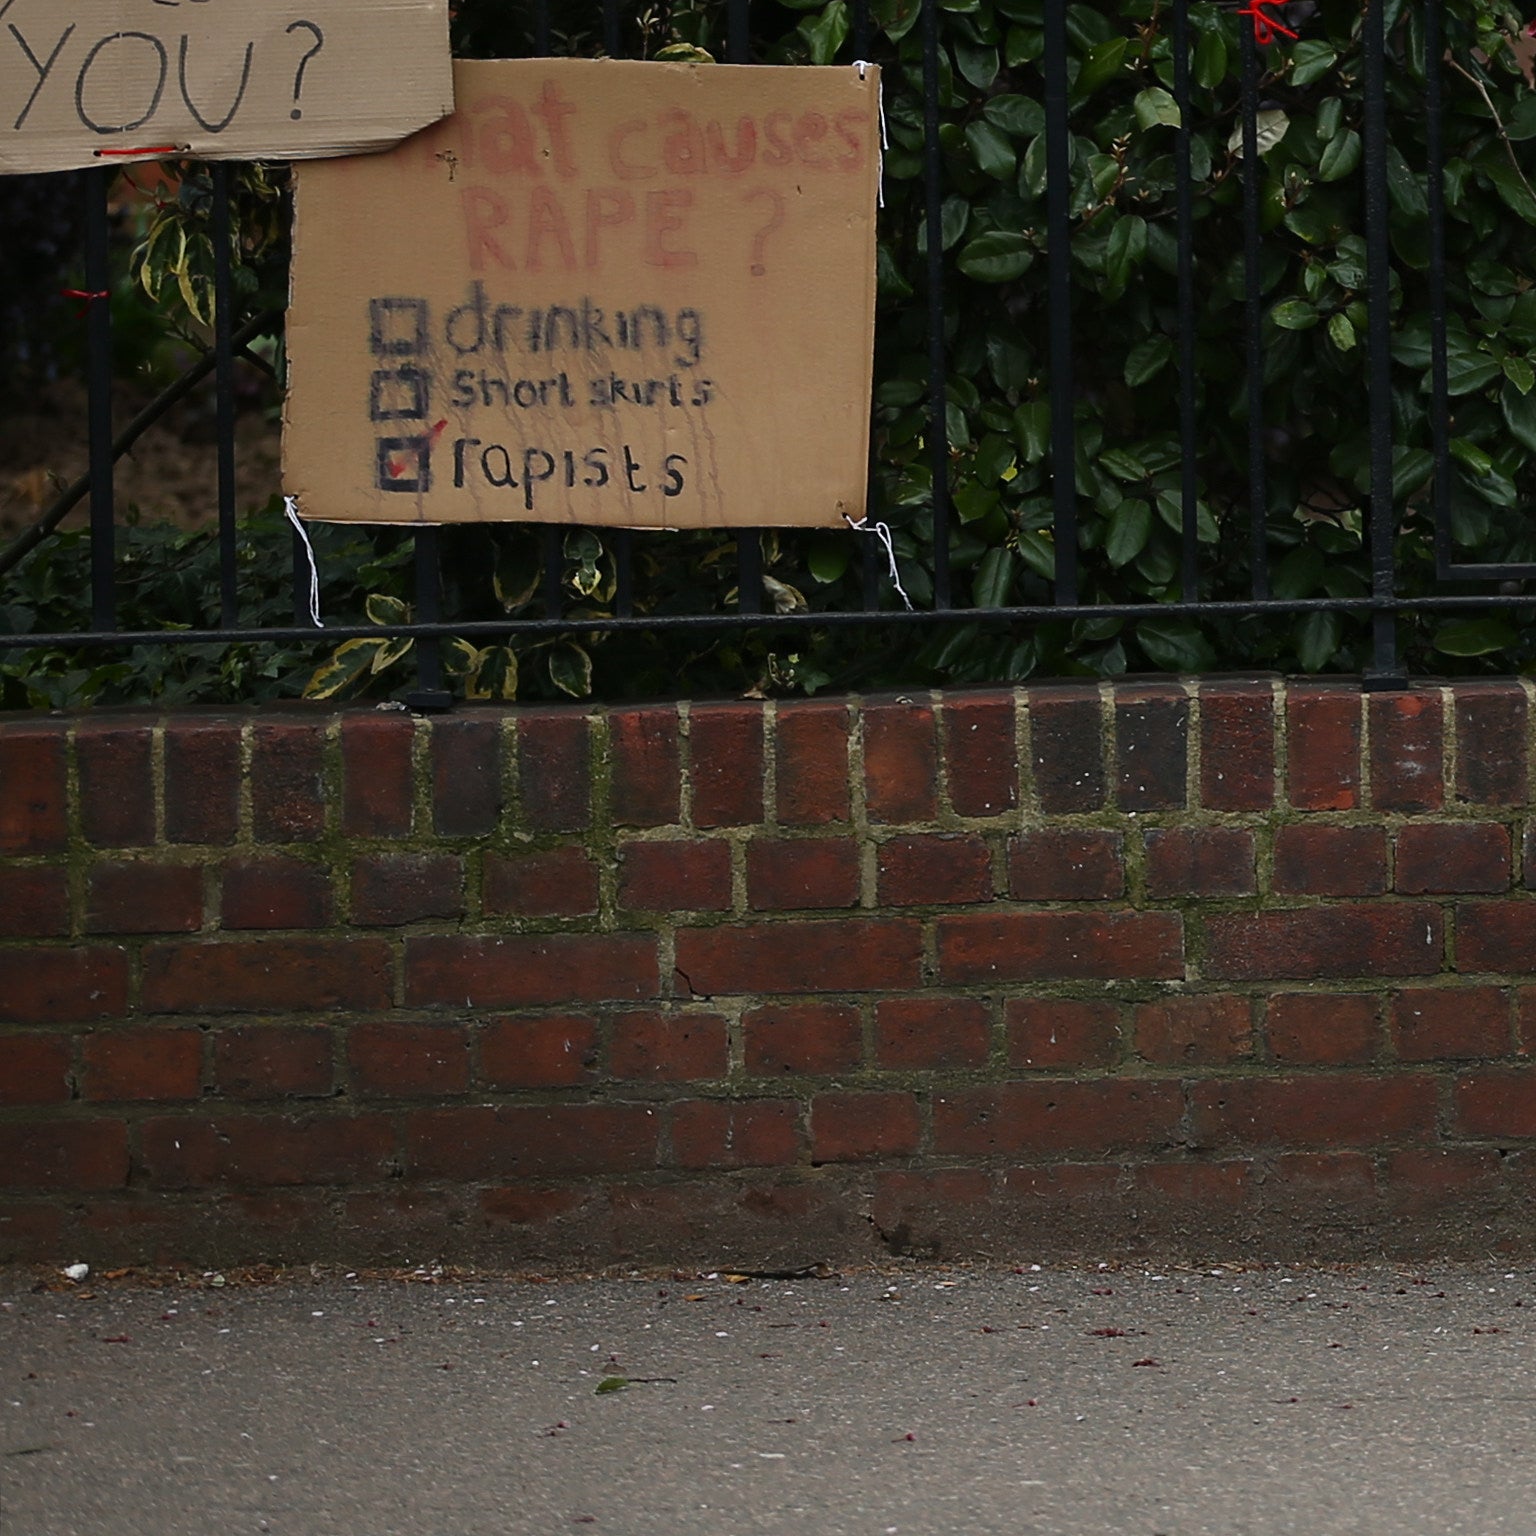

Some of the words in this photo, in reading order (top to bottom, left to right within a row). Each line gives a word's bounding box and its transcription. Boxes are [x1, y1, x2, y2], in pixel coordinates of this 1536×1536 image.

[608, 106, 870, 181] causes
[444, 279, 705, 368] drinking
[589, 371, 717, 408] skirts
[452, 437, 689, 510] rapists
